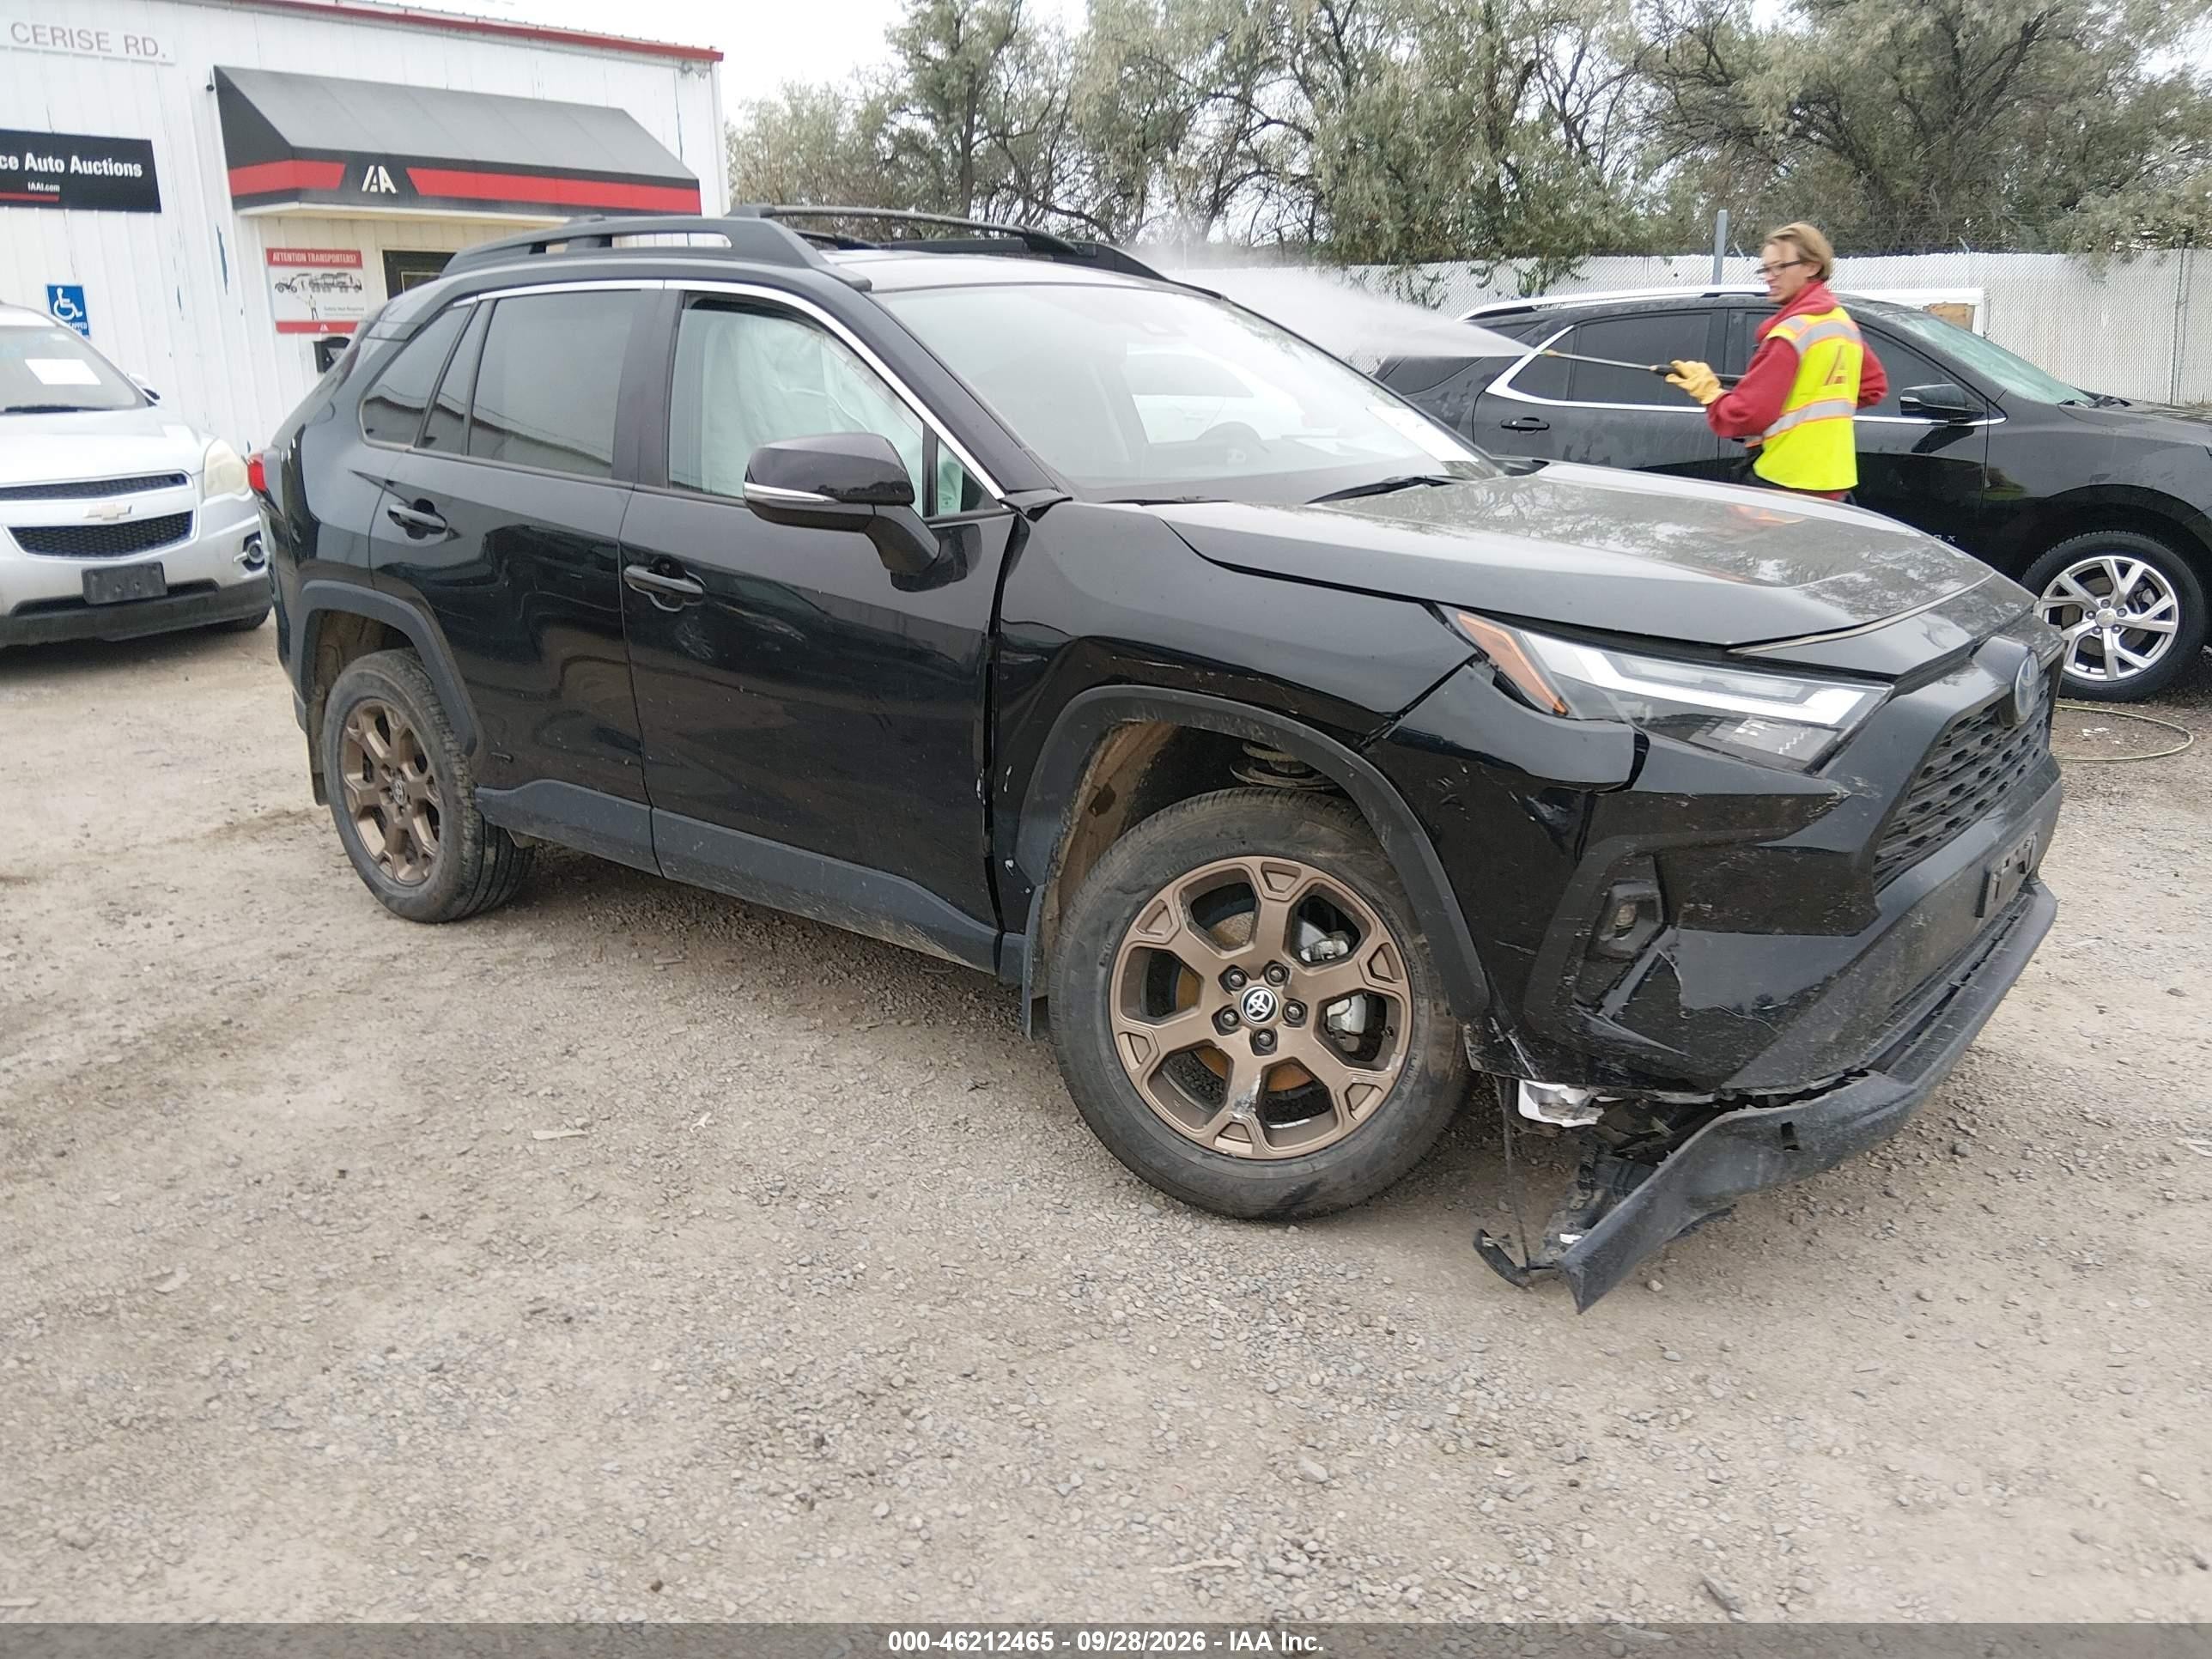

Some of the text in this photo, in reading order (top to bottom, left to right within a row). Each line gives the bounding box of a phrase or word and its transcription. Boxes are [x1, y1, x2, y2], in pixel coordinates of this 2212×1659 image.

[10, 21, 167, 58] CERISE RD.
[0, 152, 143, 178] ce Auto Auctions
[272, 252, 307, 262] ATTENTION
